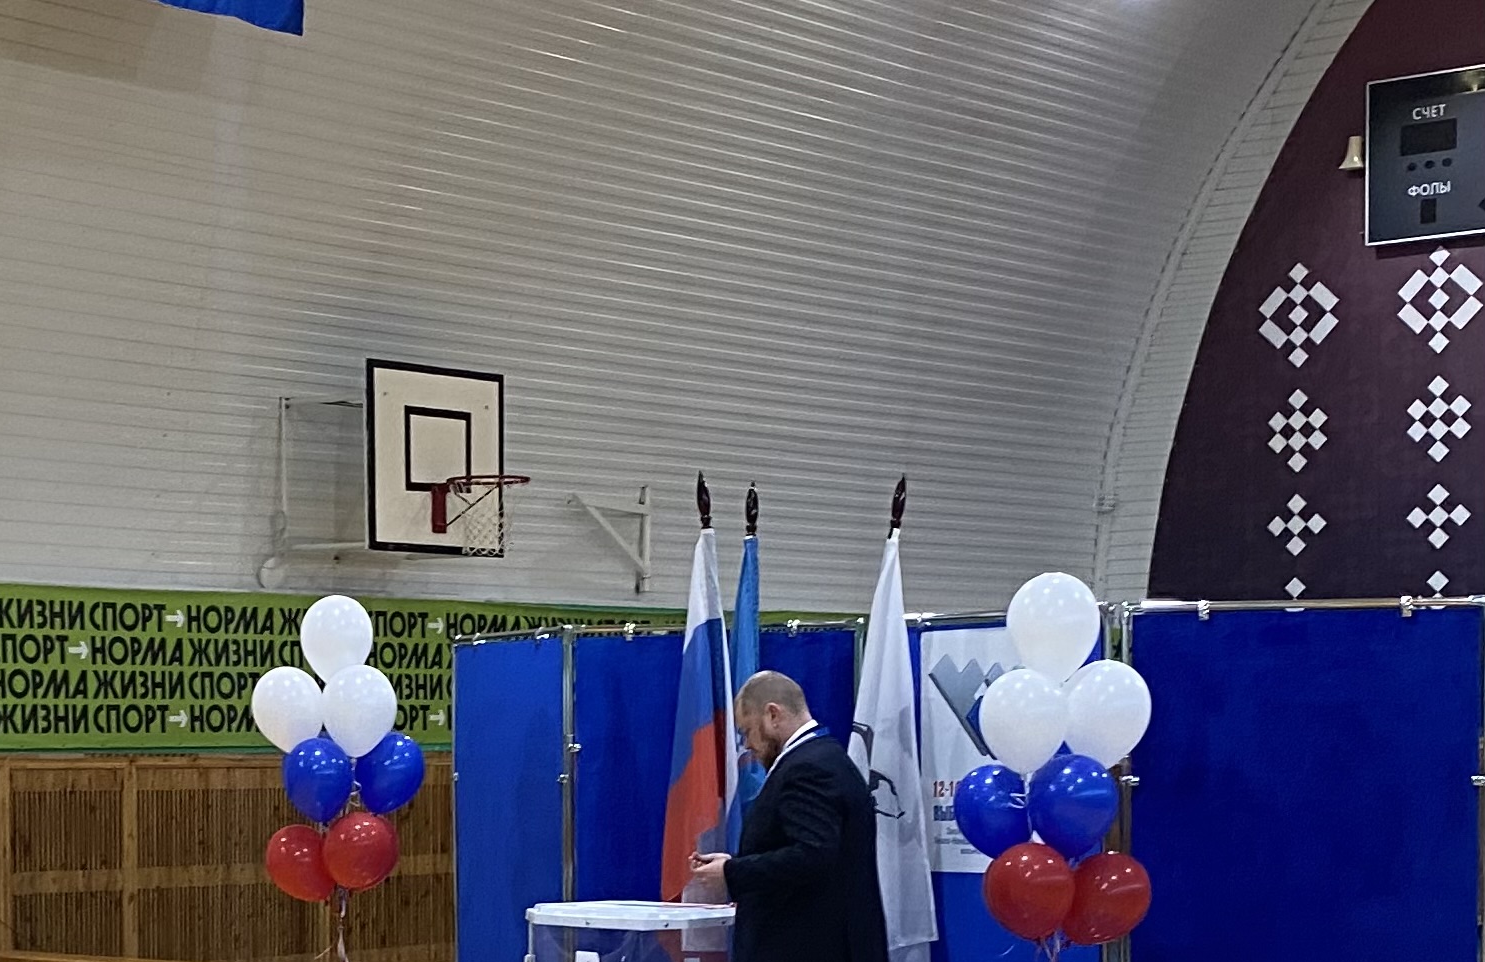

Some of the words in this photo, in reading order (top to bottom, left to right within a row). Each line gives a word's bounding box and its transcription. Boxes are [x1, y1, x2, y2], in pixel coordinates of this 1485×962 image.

[1412, 104, 1447, 120] СЧЕТ
[1407, 180, 1451, 197] ФОЛЫ
[89, 602, 166, 632] СПОРТ
[187, 605, 274, 635] НОРМА
[91, 636, 183, 666] НОРМА
[188, 638, 275, 668] ЖИЗНИ
[93, 670, 185, 700] ЖИЗНИ
[389, 673, 443, 700] ИЗНИ
[93, 704, 169, 733] СПОРТ
[190, 704, 260, 732] НОРМ
[394, 704, 430, 731] ОРТ
[933, 781, 961, 798] 12-1
